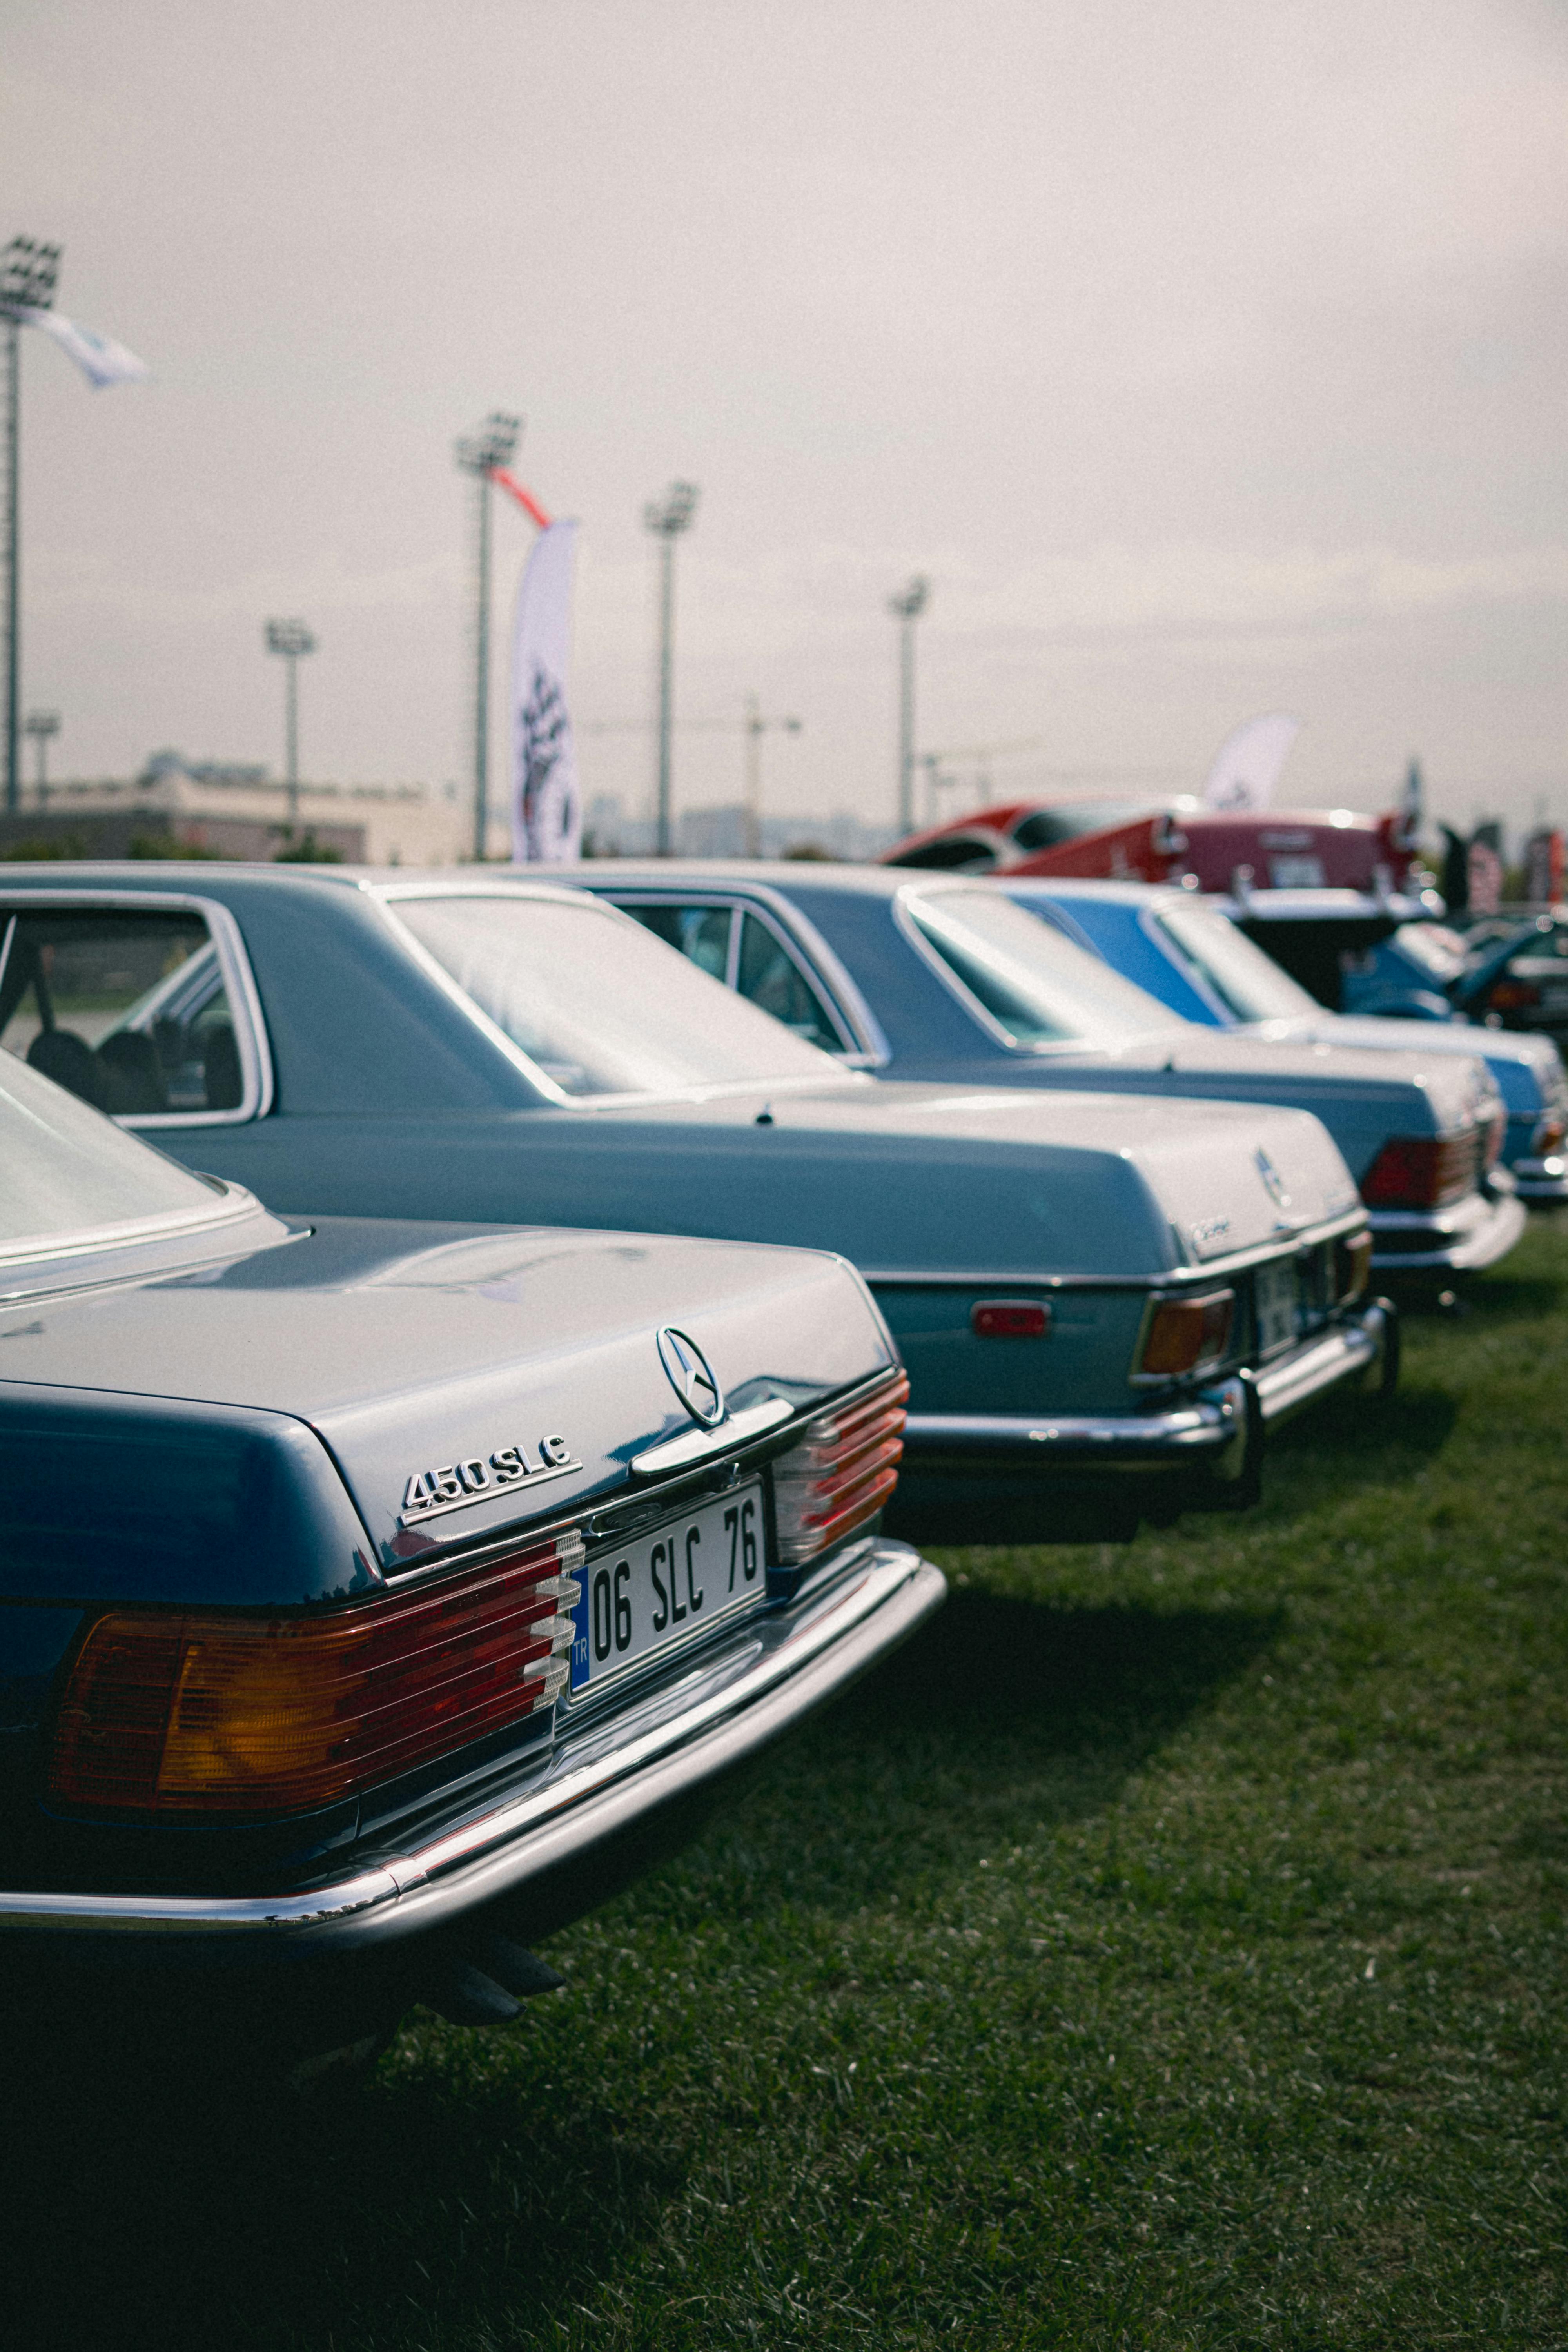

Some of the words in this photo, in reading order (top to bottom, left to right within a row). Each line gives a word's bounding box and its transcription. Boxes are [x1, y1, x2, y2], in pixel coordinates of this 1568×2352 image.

[593, 1559, 632, 1662] 06
[651, 1523, 704, 1632] SLC
[724, 1497, 757, 1593] 76
[573, 1637, 588, 1666] TR
